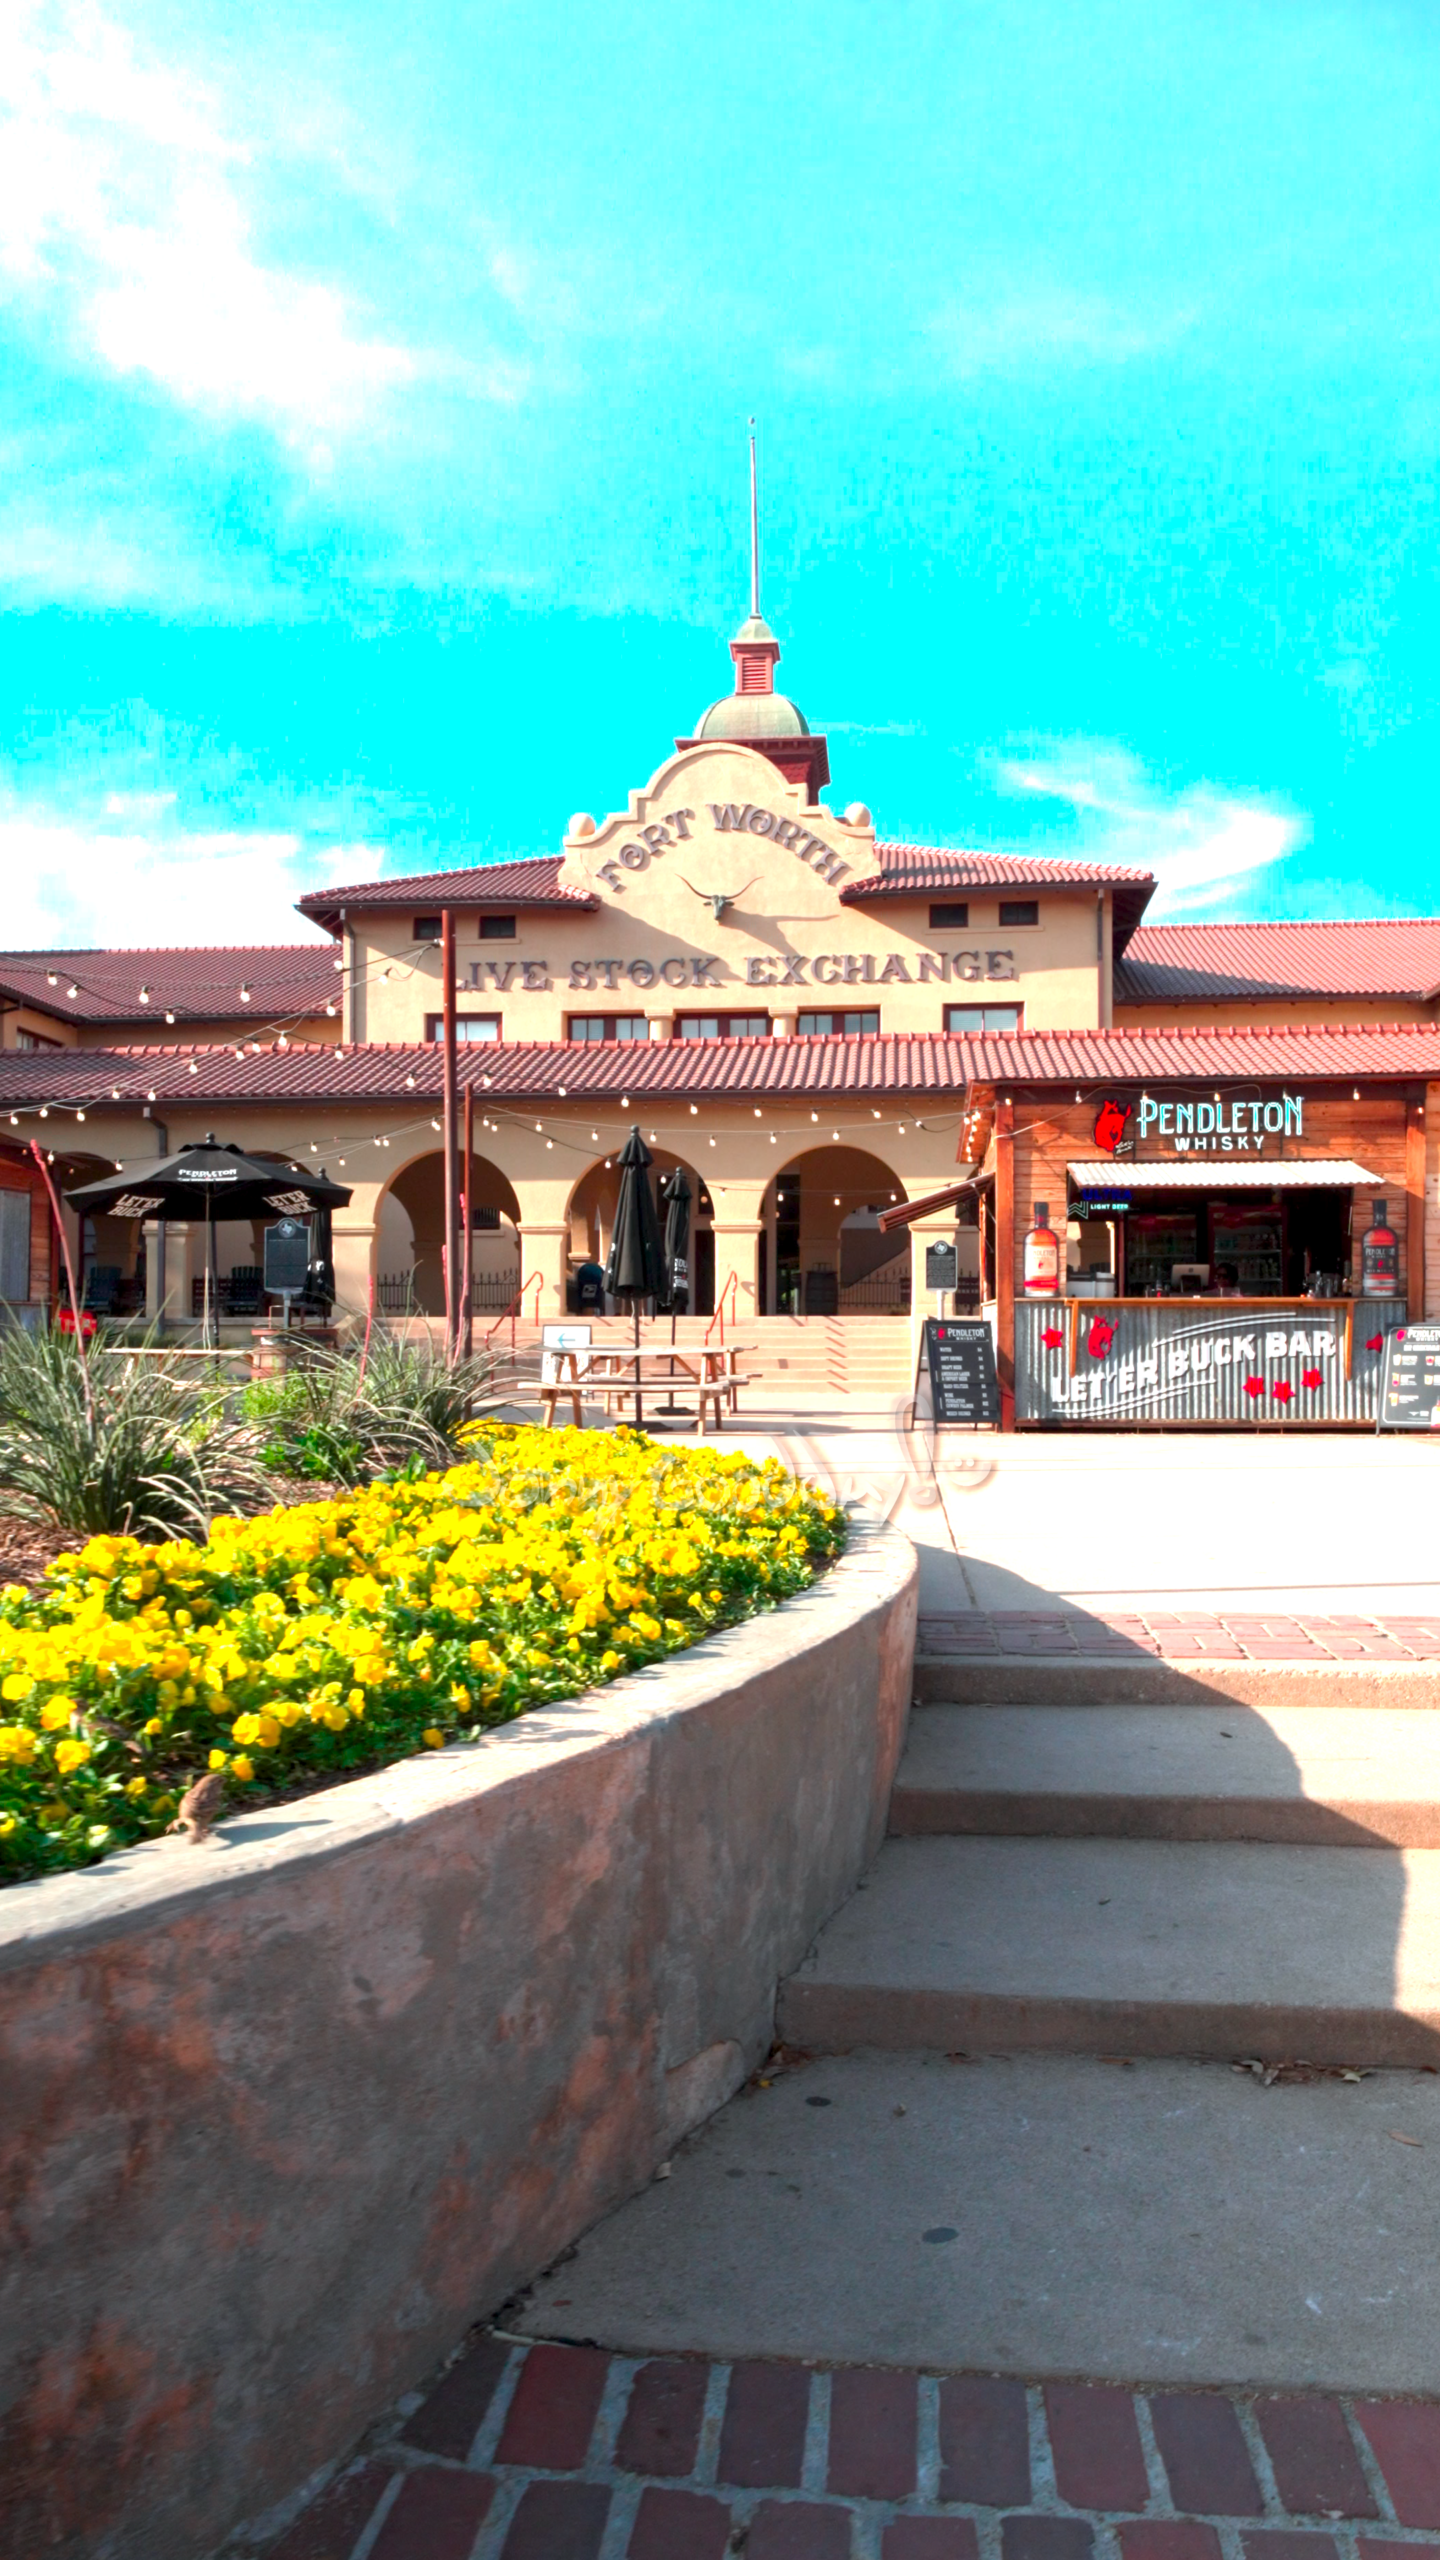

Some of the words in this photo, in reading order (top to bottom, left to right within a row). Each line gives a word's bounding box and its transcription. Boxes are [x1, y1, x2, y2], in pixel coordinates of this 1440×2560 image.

[595, 807, 690, 893] FORT
[706, 803, 852, 888] WORTH
[568, 957, 720, 990] STOCK
[745, 950, 1015, 986] EXCHANGE
[1137, 1096, 1302, 1139] PENDLETON
[1175, 1136, 1264, 1151] WHISKY
[1083, 1188, 1132, 1200] ULTRA
[107, 1205, 149, 1217] BUCK
[277, 1202, 318, 1214] BUCK
[947, 1328, 985, 1337] PENDLETON
[1051, 1358, 1158, 1402] LET'ER
[1168, 1333, 1256, 1379] BUCK
[1265, 1330, 1337, 1358] BAR
